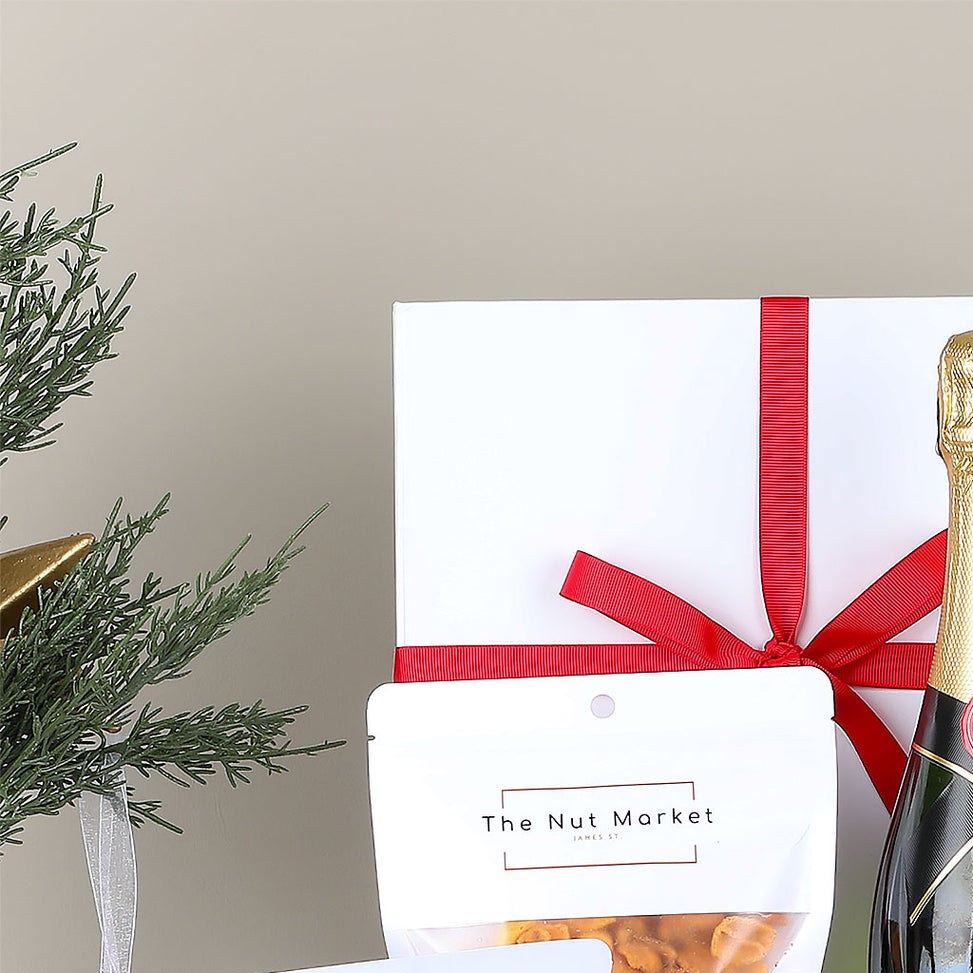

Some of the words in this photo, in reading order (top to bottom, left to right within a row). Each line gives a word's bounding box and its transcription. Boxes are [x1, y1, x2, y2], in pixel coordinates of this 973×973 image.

[482, 815, 532, 832] The
[549, 813, 597, 830] Nut
[613, 808, 713, 827] Market
[573, 834, 603, 842] JAMES
